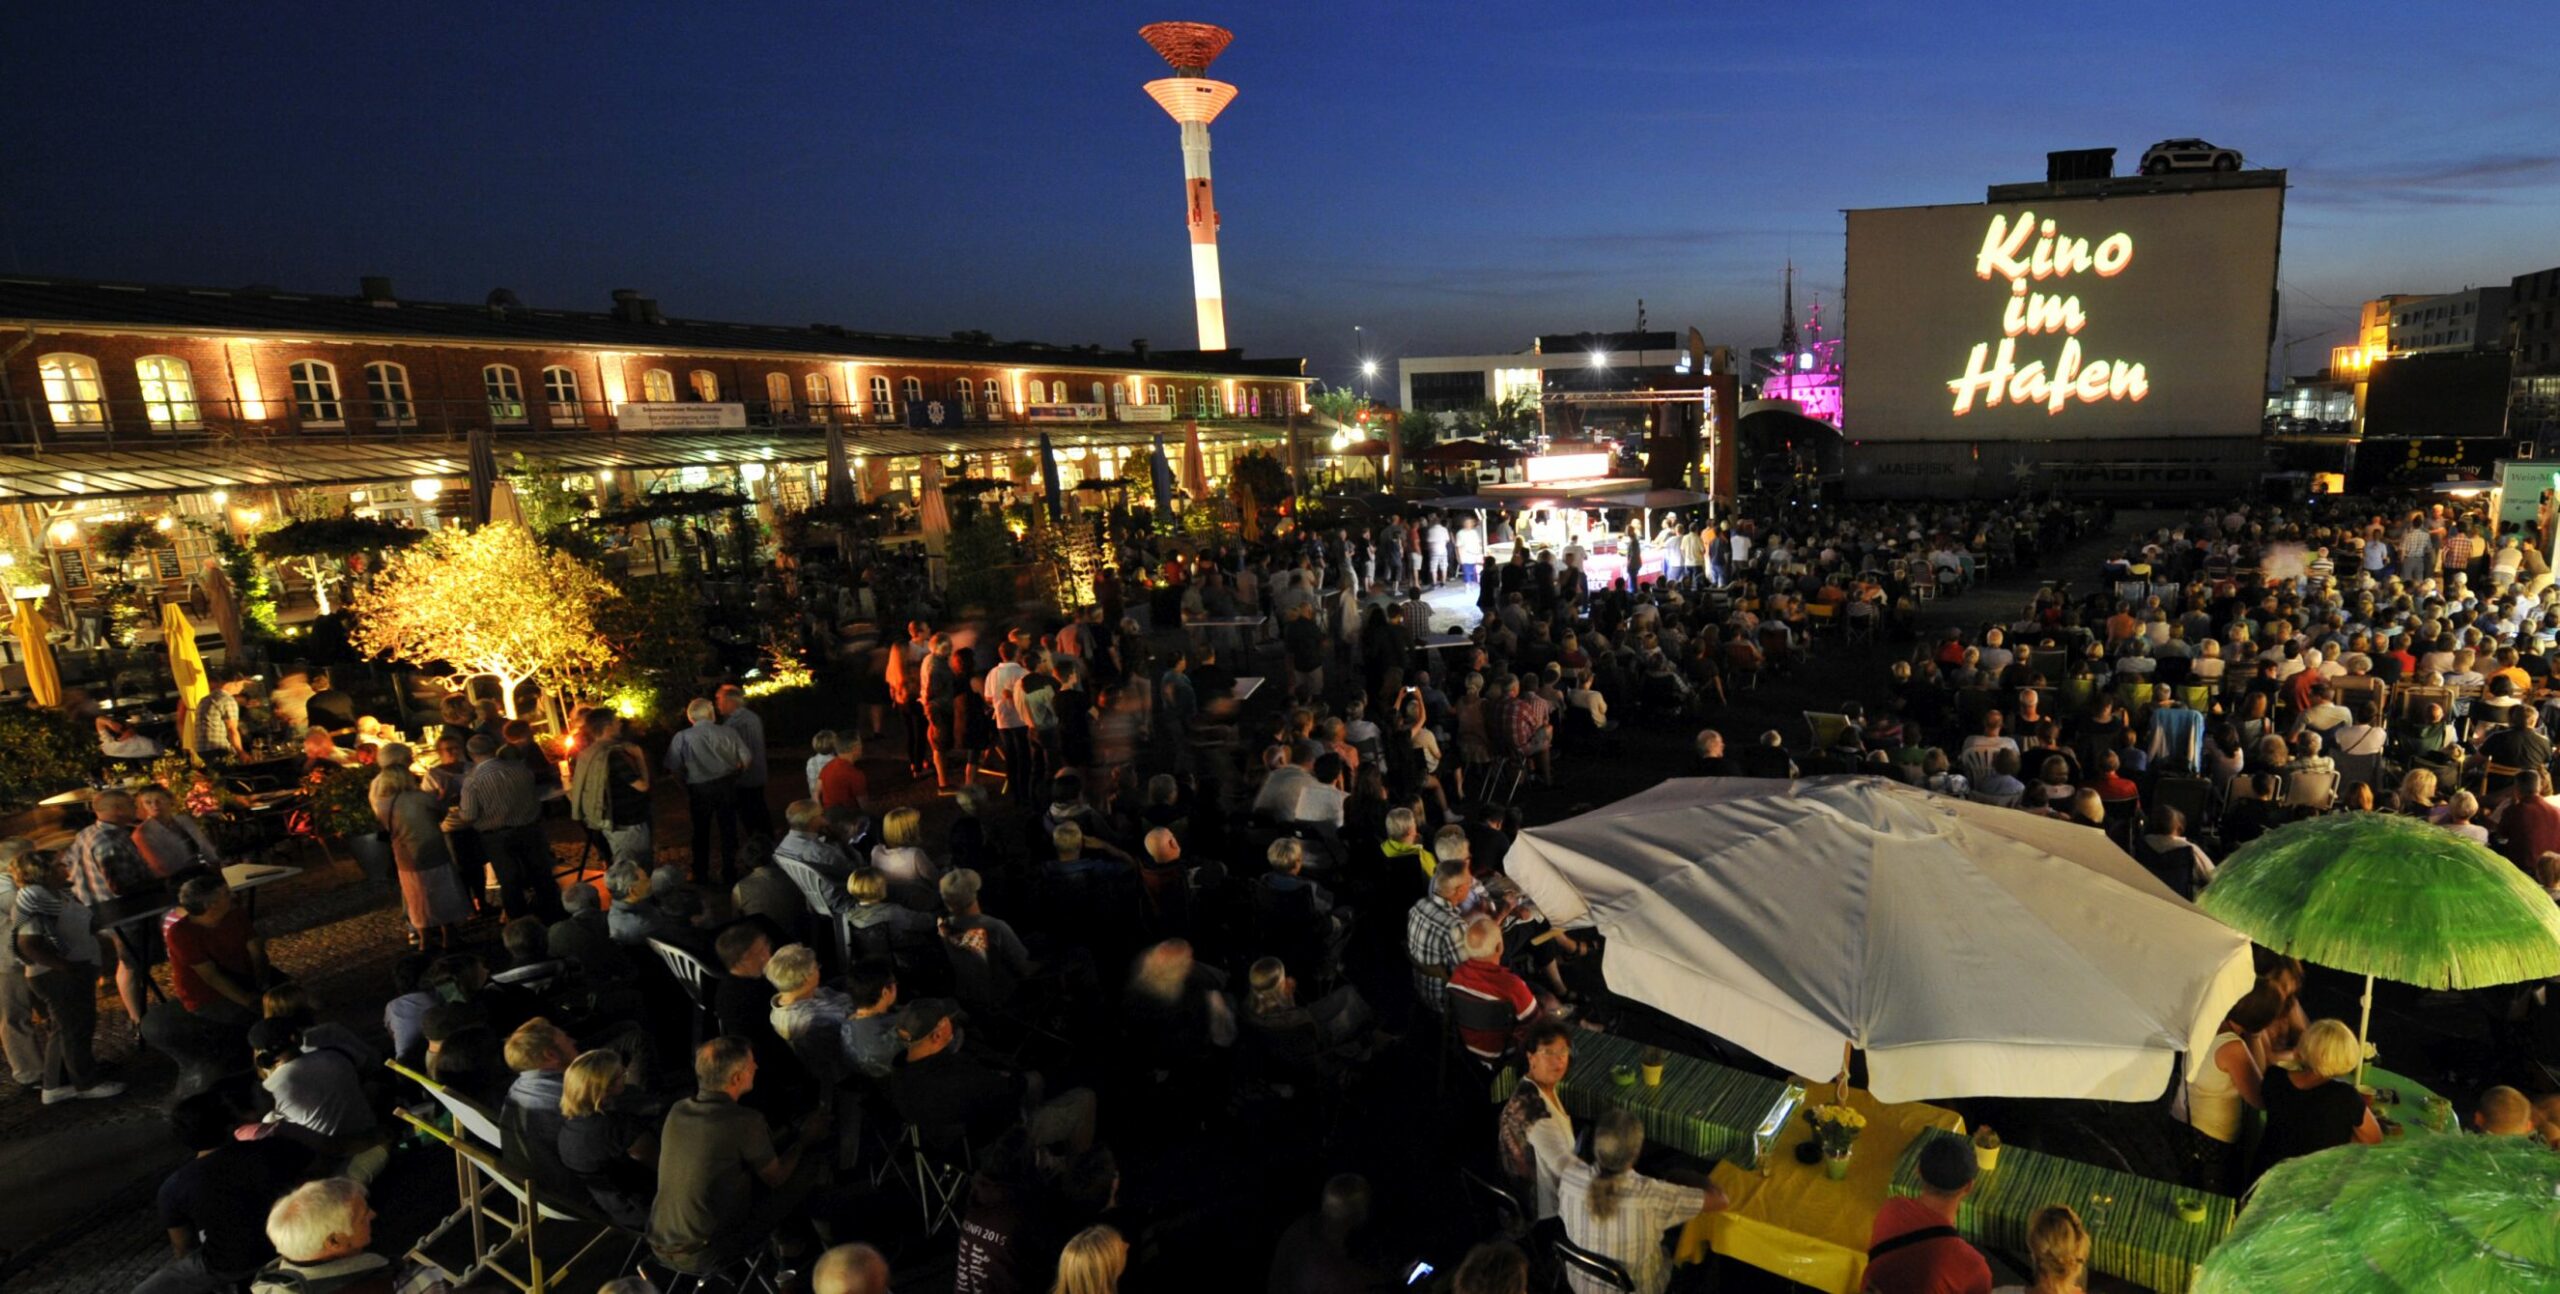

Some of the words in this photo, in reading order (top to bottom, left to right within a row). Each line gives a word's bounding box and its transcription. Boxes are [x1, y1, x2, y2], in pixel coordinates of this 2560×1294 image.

[1976, 211, 2133, 282] Kino
[2003, 277, 2087, 337] im
[1946, 336, 2149, 416] Hafen
[1877, 463, 1955, 475] MAERSK
